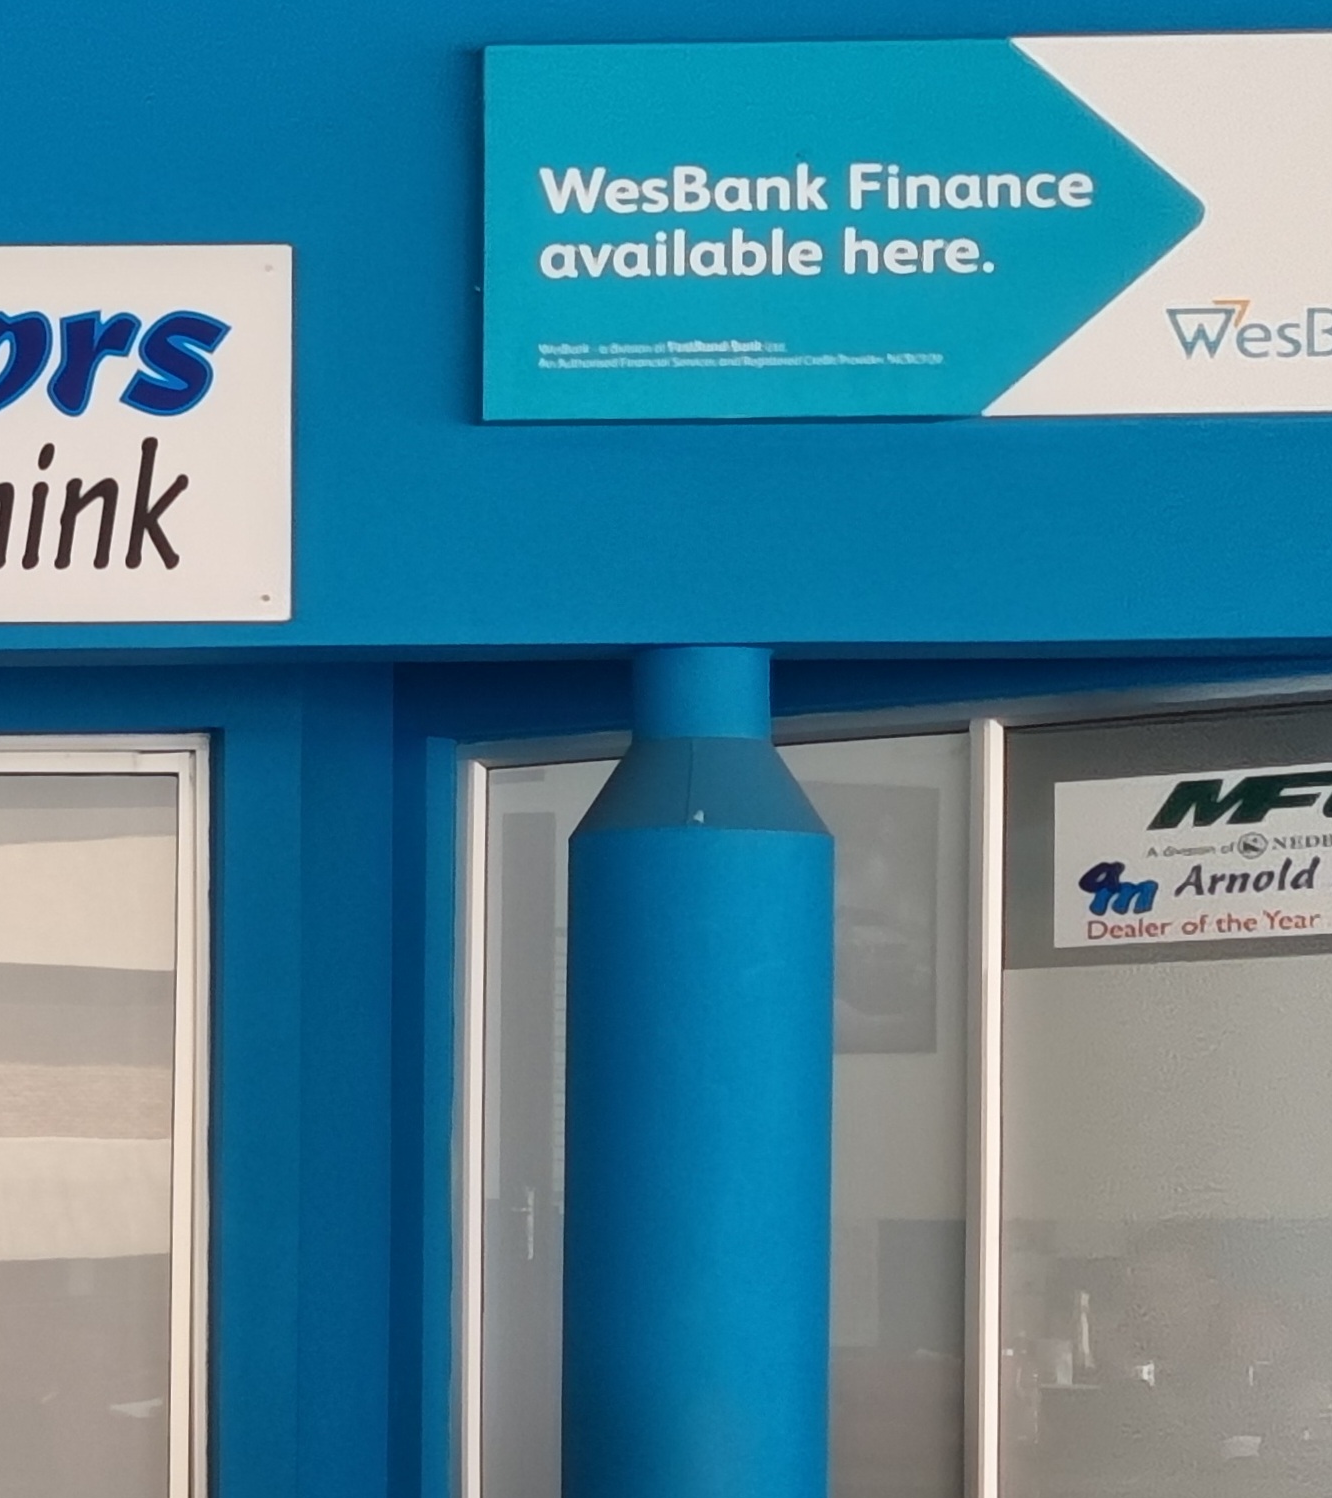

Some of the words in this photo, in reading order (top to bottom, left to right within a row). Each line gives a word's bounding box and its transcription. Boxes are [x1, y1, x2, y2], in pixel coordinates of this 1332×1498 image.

[539, 162, 829, 215] WesBank
[849, 161, 1095, 212] Finance
[539, 227, 823, 279] available
[843, 226, 996, 275] here.
[1174, 855, 1321, 897] Arnold
[1087, 918, 1173, 940] Dealer
[1181, 914, 1209, 935] of
[1216, 912, 1258, 934] the
[1263, 909, 1321, 931] Year
